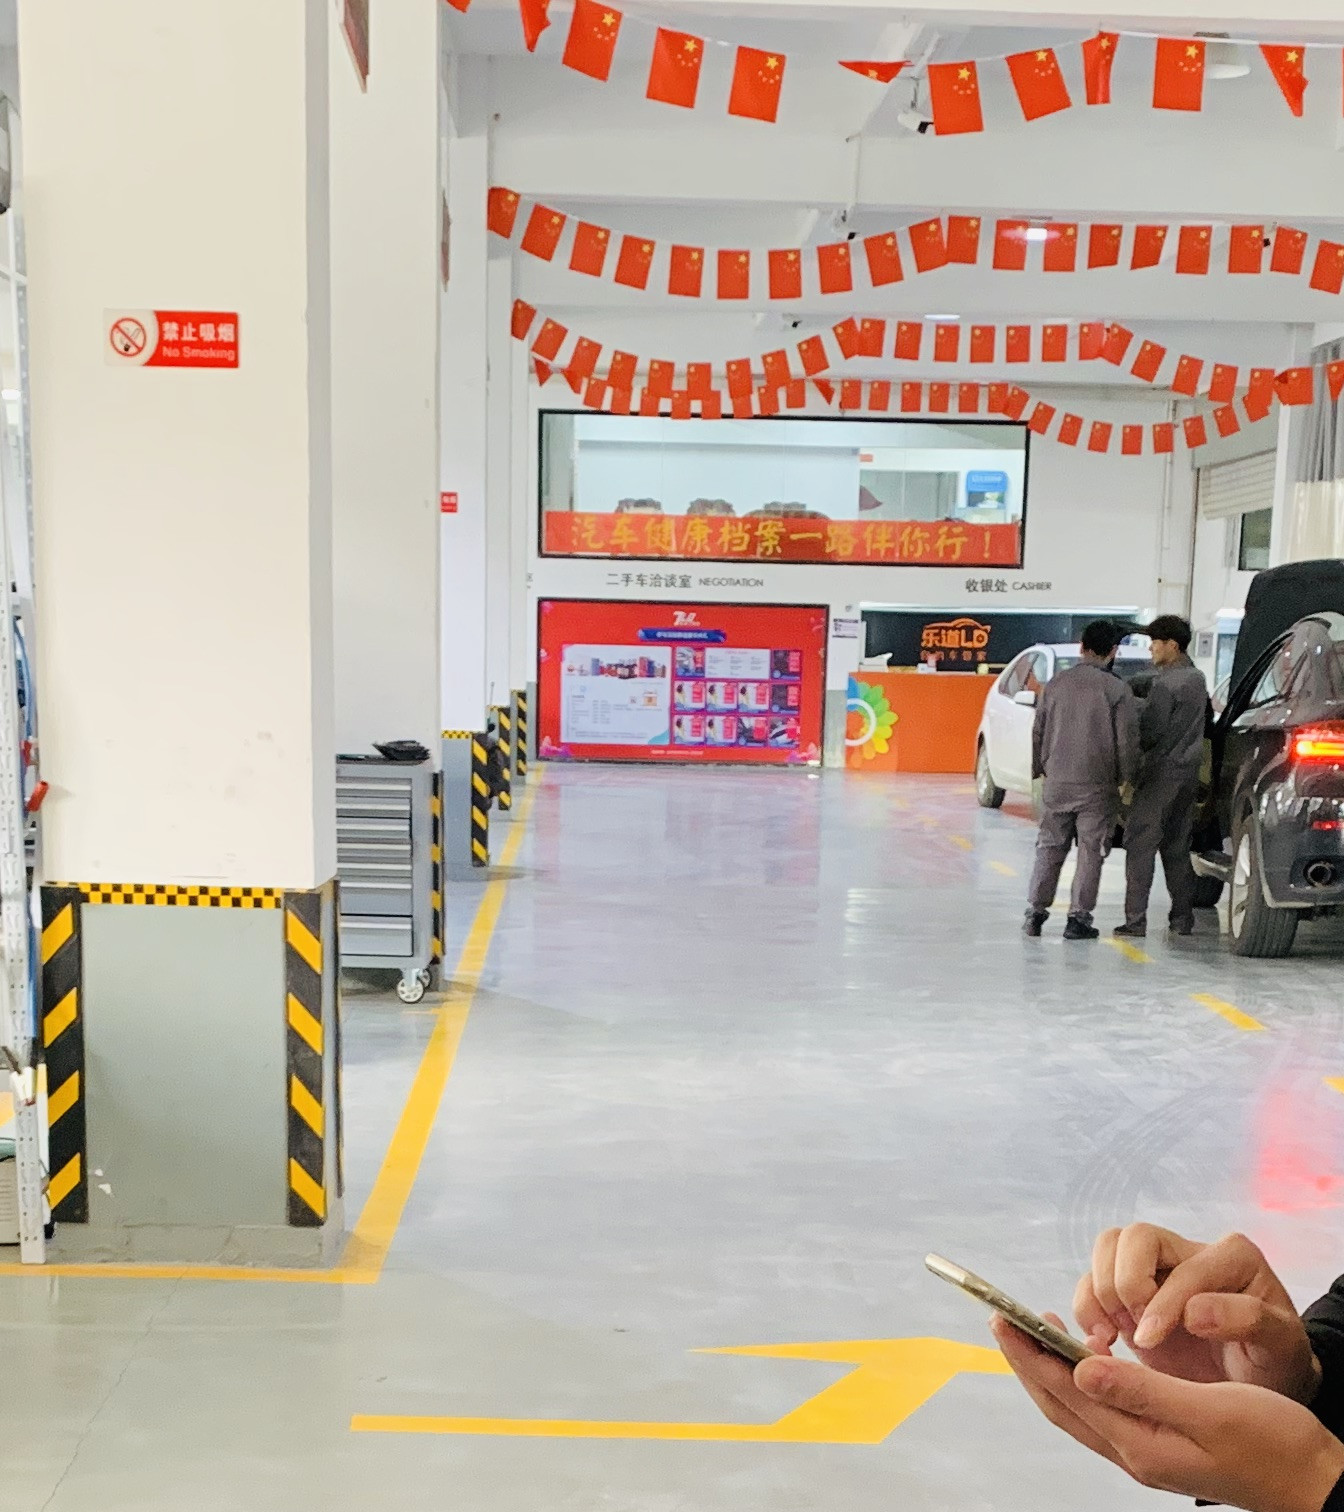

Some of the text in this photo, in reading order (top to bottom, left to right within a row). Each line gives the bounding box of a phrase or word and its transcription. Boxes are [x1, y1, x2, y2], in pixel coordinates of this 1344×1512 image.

[162, 321, 235, 343] 禁止吸烟
[162, 346, 235, 361] No Smoking
[571, 516, 992, 560] 汽车健康档案一路伴你行！
[606, 573, 764, 588] 二手车洽谈室 NEGOTIATION
[965, 578, 1052, 593] 收银处 CASHIER
